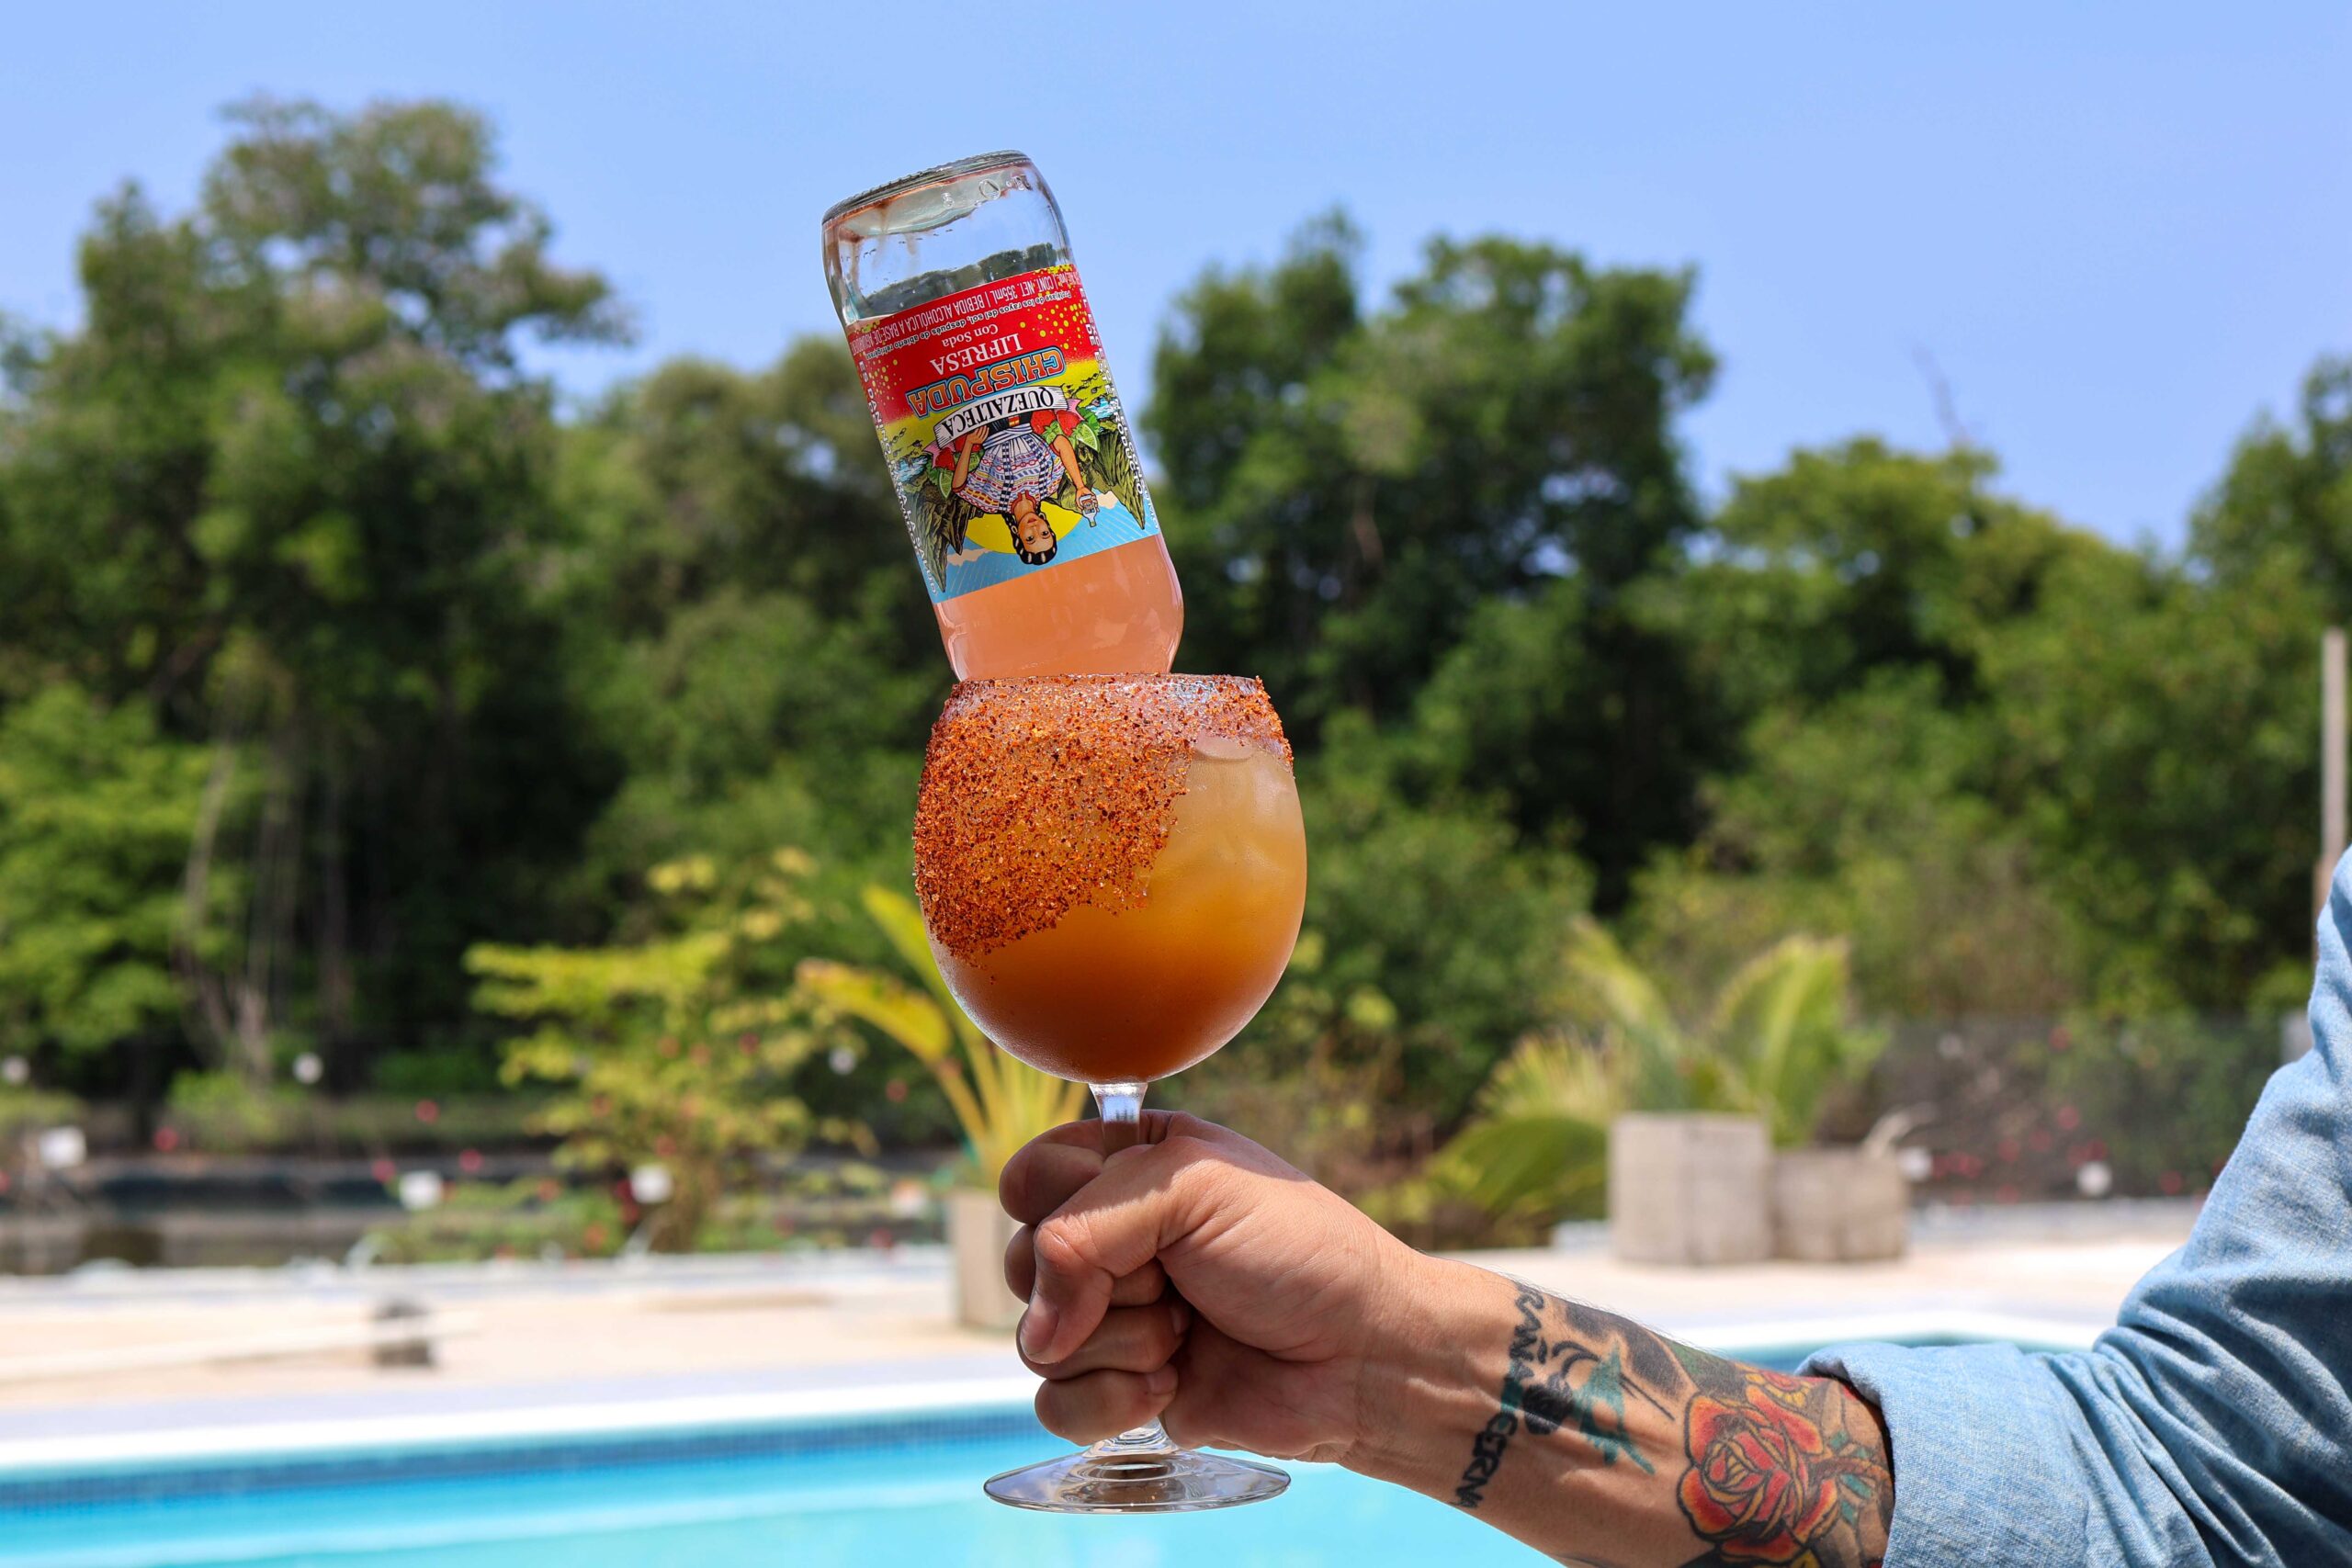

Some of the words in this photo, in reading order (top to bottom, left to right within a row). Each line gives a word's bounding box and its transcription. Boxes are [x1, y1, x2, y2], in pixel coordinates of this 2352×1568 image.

[989, 284, 1018, 304] 355mL
[1015, 279, 1035, 297] NET.
[951, 294, 985, 316] BEBIDA
[998, 300, 1022, 314] rayos
[1022, 299, 1035, 308] los
[1035, 296, 1045, 305] de
[903, 302, 955, 333] ALCOHÓLICA
[966, 312, 983, 324] sol,
[984, 309, 999, 320] del
[879, 321, 899, 342] BASE
[896, 320, 906, 335] A
[919, 330, 931, 341] de
[931, 317, 967, 337] después
[972, 323, 999, 338] Con
[871, 328, 883, 344] DE
[893, 333, 920, 350] abierto
[942, 331, 971, 348] Soda
[930, 333, 1023, 375] LIFRESA
[906, 347, 1066, 417] CHISPUDA
[942, 387, 1055, 434] QUEZALTECA
[1084, 322, 1097, 346] DE
[1109, 399, 1144, 495] PRODUCTO
[857, 359, 869, 383] ES
[914, 536, 938, 595] SALUD
